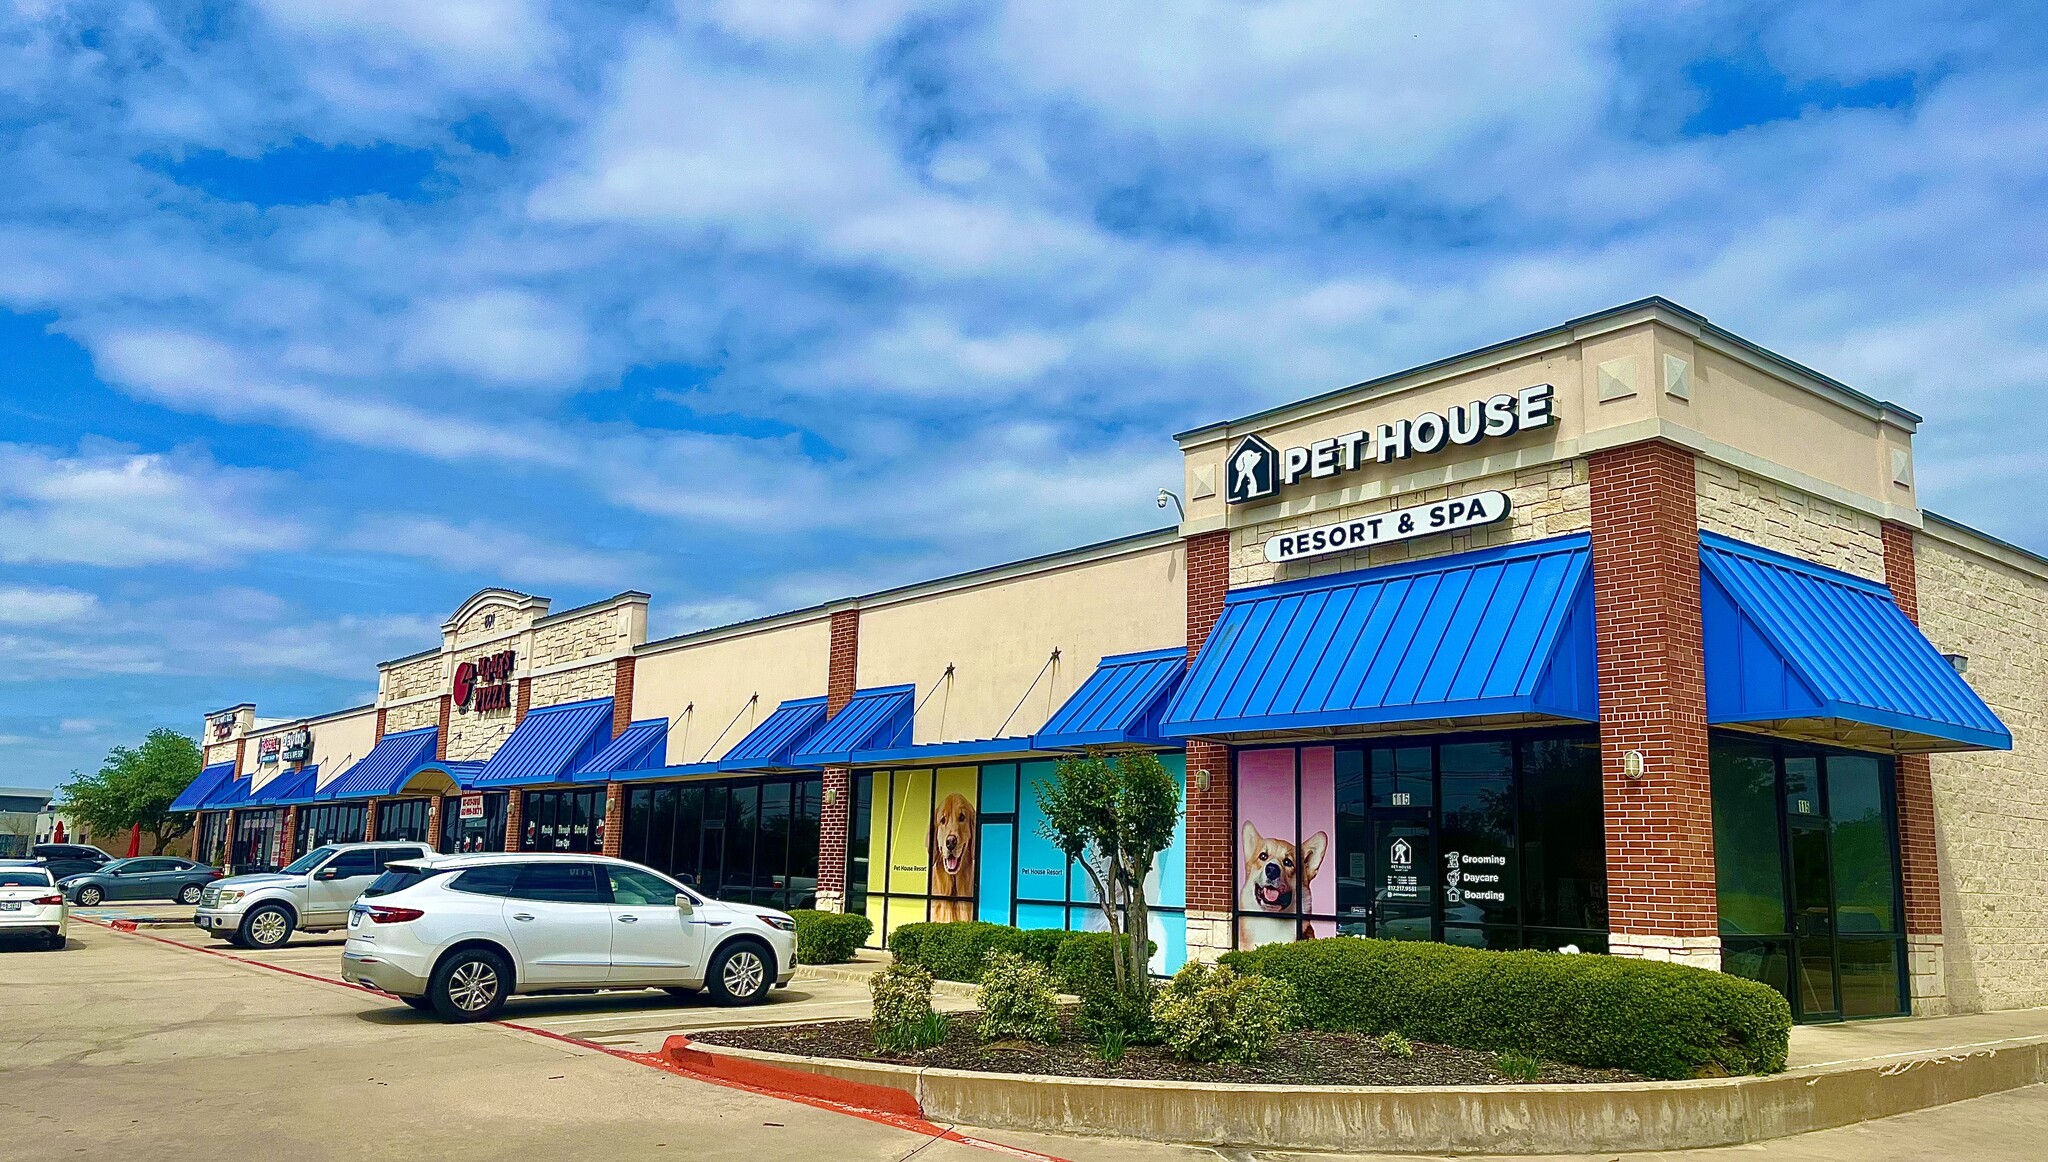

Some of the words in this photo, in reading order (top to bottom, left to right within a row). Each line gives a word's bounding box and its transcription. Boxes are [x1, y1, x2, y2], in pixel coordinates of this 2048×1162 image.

[1284, 430, 1369, 485] PET
[1376, 383, 1554, 464] HOUSE
[1279, 518, 1383, 558] RESORT
[1397, 512, 1416, 535] &
[1429, 497, 1487, 528] SPA
[478, 650, 514, 682] MAMA'S
[474, 683, 510, 712] PIZZA
[1393, 793, 1409, 805] 115
[1799, 801, 1809, 812] 115
[1462, 854, 1506, 866] Grooming
[1463, 873, 1499, 883] Daycare
[1464, 890, 1505, 902] Boarding
